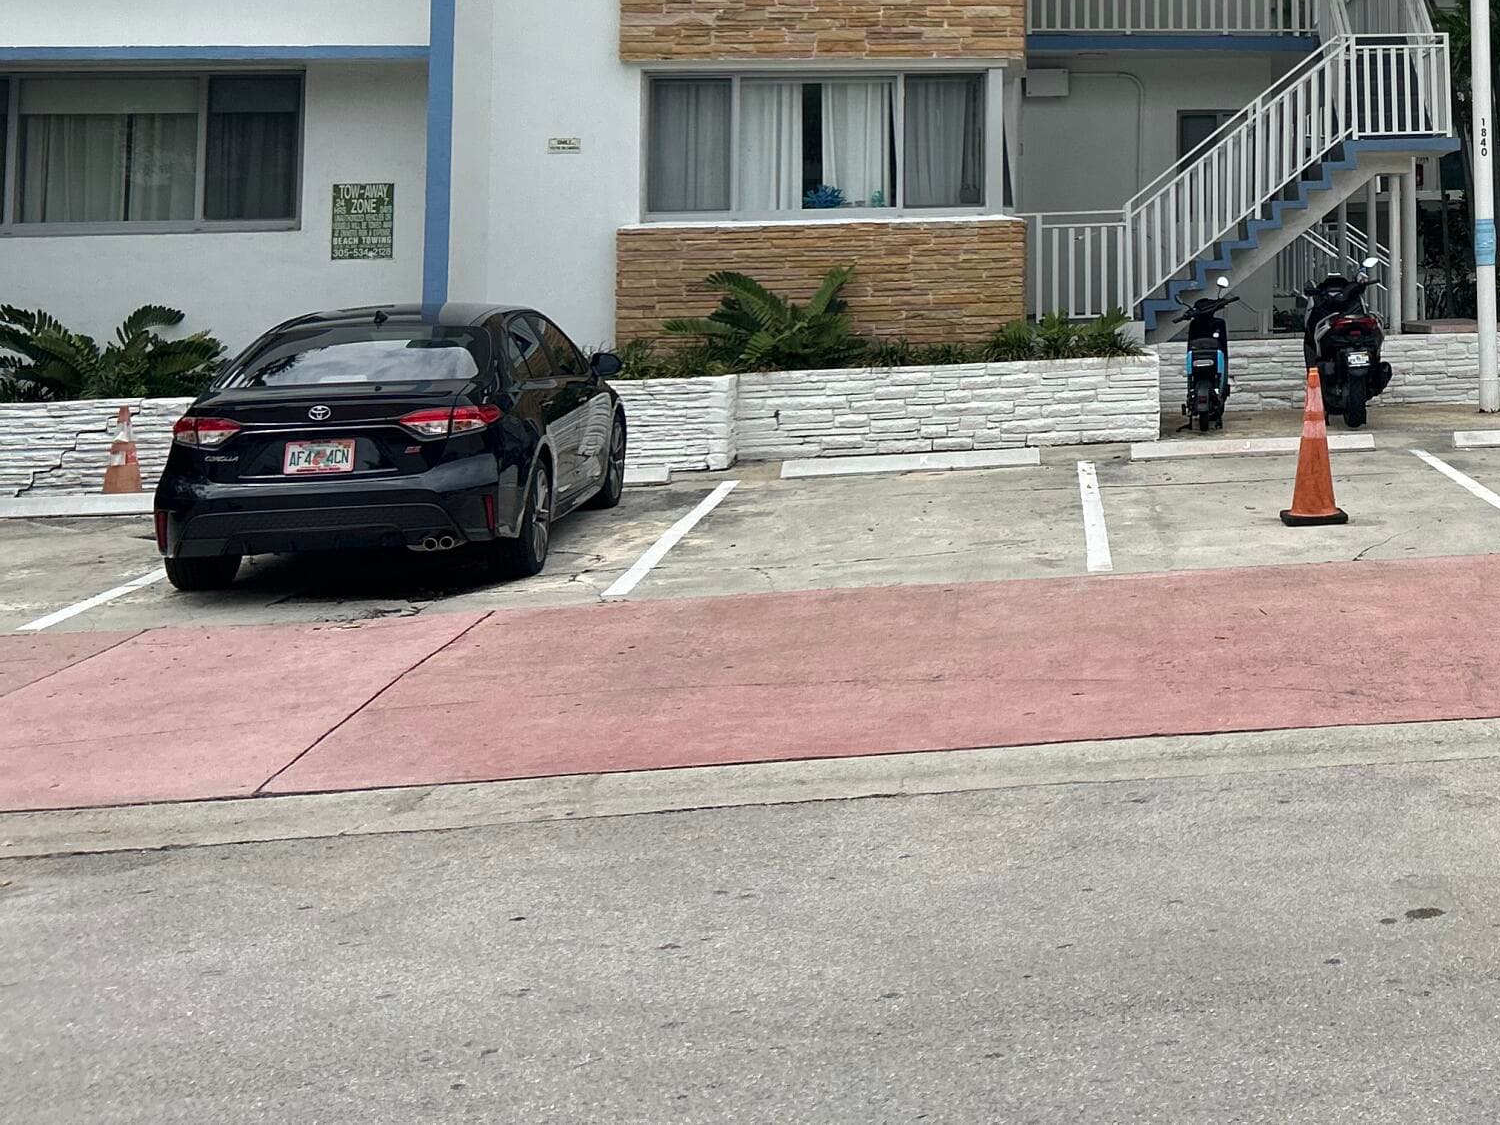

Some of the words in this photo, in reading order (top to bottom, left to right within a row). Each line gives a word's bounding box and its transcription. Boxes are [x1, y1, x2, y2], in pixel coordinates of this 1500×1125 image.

[1480, 117, 1488, 157] 1840
[339, 184, 389, 199] TOW-AWAY
[335, 198, 345, 207] 24
[350, 198, 377, 214] ZONE
[383, 197, 389, 206] 7
[332, 236, 359, 245] BEACH
[361, 236, 392, 245] TOWING
